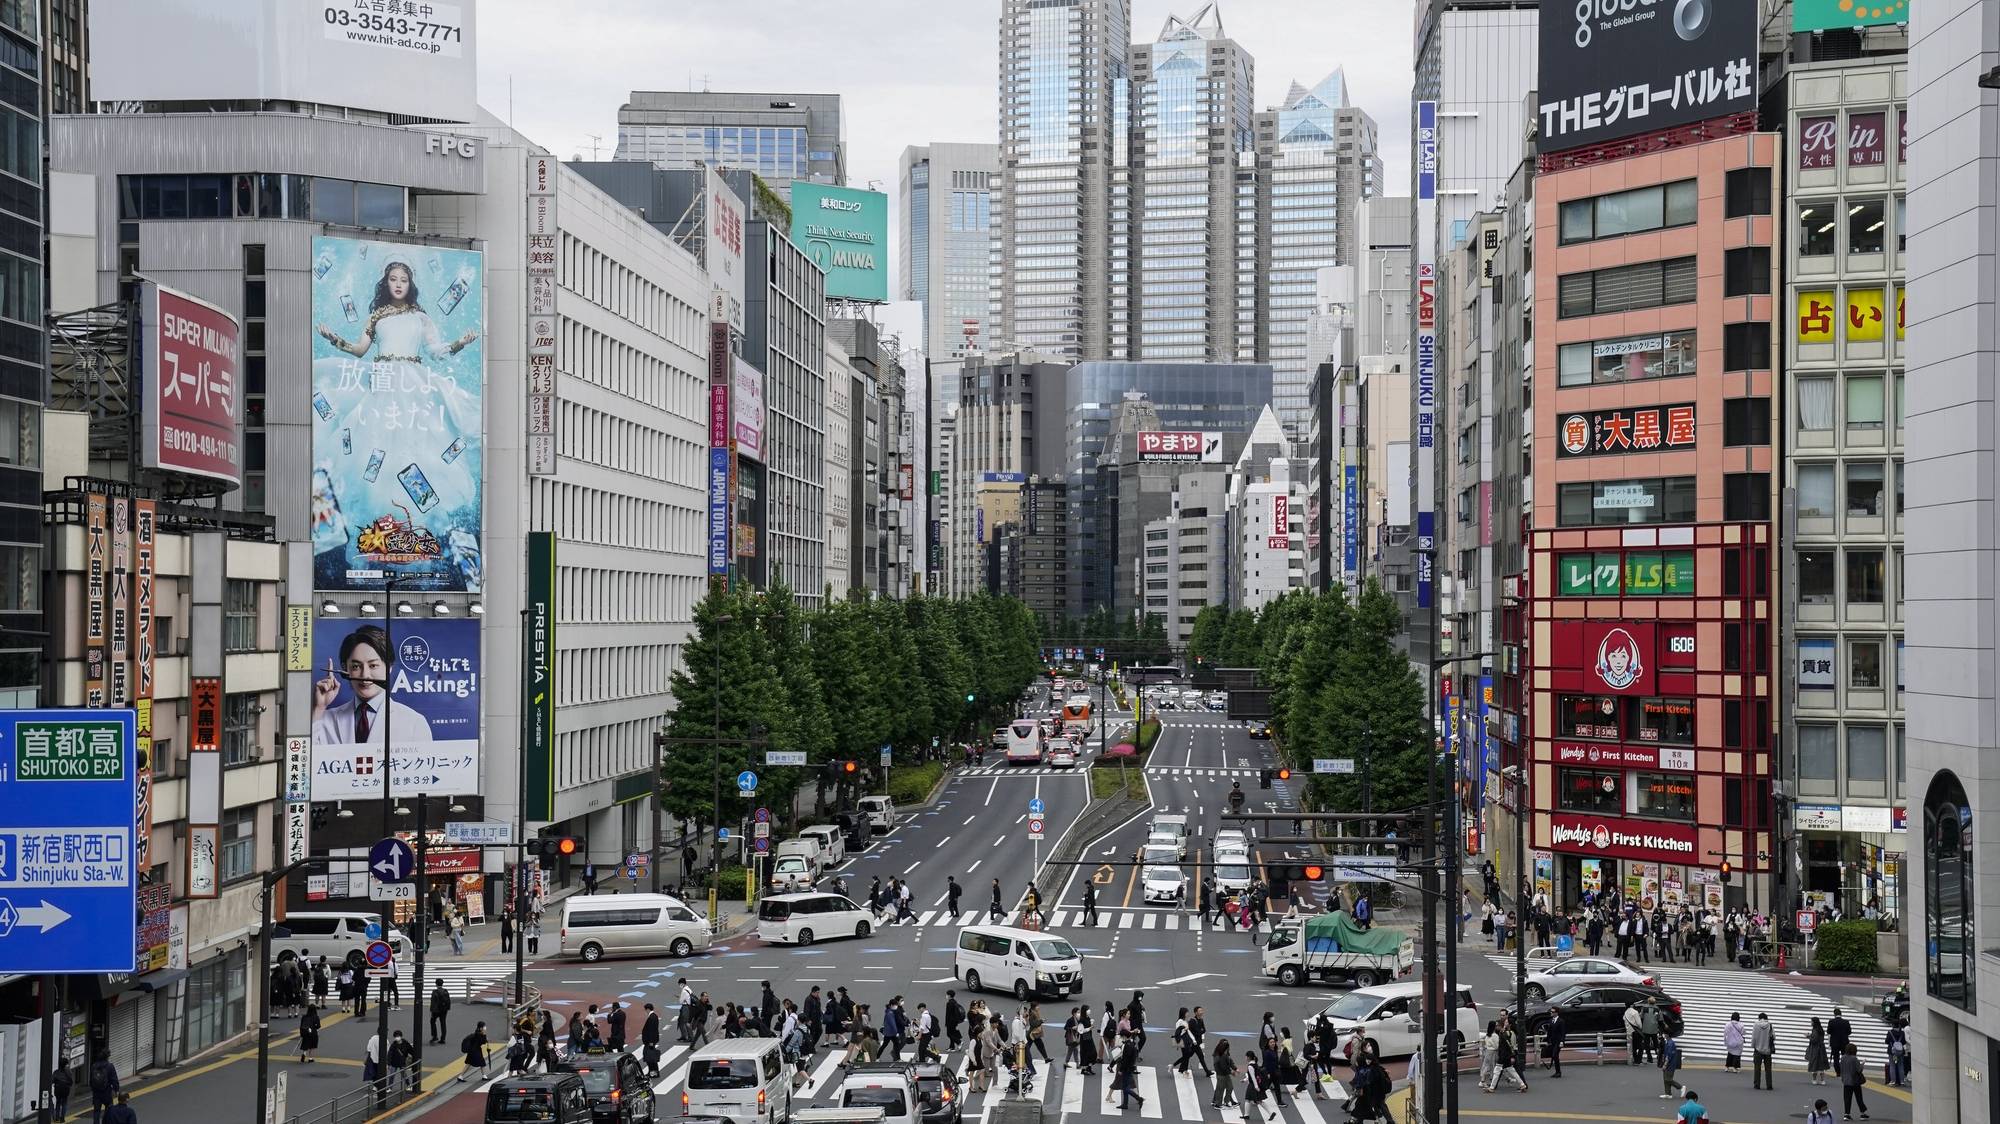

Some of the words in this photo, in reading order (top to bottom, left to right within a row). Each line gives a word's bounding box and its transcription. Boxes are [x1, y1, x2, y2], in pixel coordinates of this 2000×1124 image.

[354, 0, 433, 19] 広告募集中
[1600, 21, 1612, 31] The
[1613, 15, 1634, 28] Global
[1635, 10, 1656, 24] Group
[324, 7, 461, 43] 03-3543-7771
[346, 31, 441, 54] www.hit-ad.co.jp
[1540, 57, 1751, 138] THEグローバル社
[425, 133, 476, 159] FPG
[1425, 143, 1434, 174] LABI
[537, 160, 546, 191] 久保ビル
[820, 197, 861, 212] 美和ロック
[530, 236, 554, 249] 共立
[806, 224, 828, 236] Think
[829, 227, 845, 239] Next
[846, 230, 874, 241] Security
[530, 251, 554, 264] 美容
[832, 250, 875, 270] MIWA
[1419, 279, 1434, 329] LABI
[164, 312, 201, 348] SUPER
[531, 356, 553, 365] KEN
[713, 341, 725, 378] Bloom
[1419, 335, 1434, 407] SHINJUKU
[337, 359, 468, 399] 放置しよう
[532, 365, 541, 393] スクール
[543, 365, 552, 393] パソコン
[532, 396, 541, 433] クリニック
[715, 387, 724, 440] 品川美容外科
[1419, 412, 1433, 449] 西口館
[1565, 420, 1586, 448] 質
[1603, 406, 1696, 451] 大黒屋
[173, 428, 227, 460] 0120-494-111
[1143, 434, 1199, 452] やまや
[712, 468, 726, 505] JAPAN
[712, 508, 726, 539] TOTAL
[712, 539, 725, 568] CLUB
[89, 515, 104, 640] 大黒屋
[112, 555, 127, 705] 大黒屋
[138, 549, 152, 696] エメラルド
[429, 657, 471, 672] なんでも
[1802, 659, 1831, 674] 賃貸
[391, 668, 476, 698] Asking!
[197, 691, 215, 744] 大黒屋
[1645, 704, 1664, 713] First
[1665, 704, 1695, 714] Kitch
[22, 727, 118, 759] 首都高
[1560, 746, 1586, 760] Wendy's
[1602, 751, 1620, 760] First
[1624, 752, 1654, 762] Kitchen
[21, 758, 89, 776] SHUTOKO
[94, 758, 120, 776] EXP
[317, 760, 353, 775] AGA
[376, 755, 473, 772] スキンクリニック
[351, 776, 430, 788] ここか徒歩3分
[1649, 784, 1665, 792] irst
[1666, 785, 1694, 794] Kitch
[448, 827, 508, 837] 西新宿1丁目
[1552, 823, 1591, 847] Wendy's
[1612, 832, 1642, 847] First
[1643, 835, 1693, 852] Kitchen
[22, 834, 123, 865] 新宿駅西口
[22, 865, 79, 886] Shinjuku
[83, 865, 125, 882] Sta.-W.
[377, 887, 409, 897] 7-20
